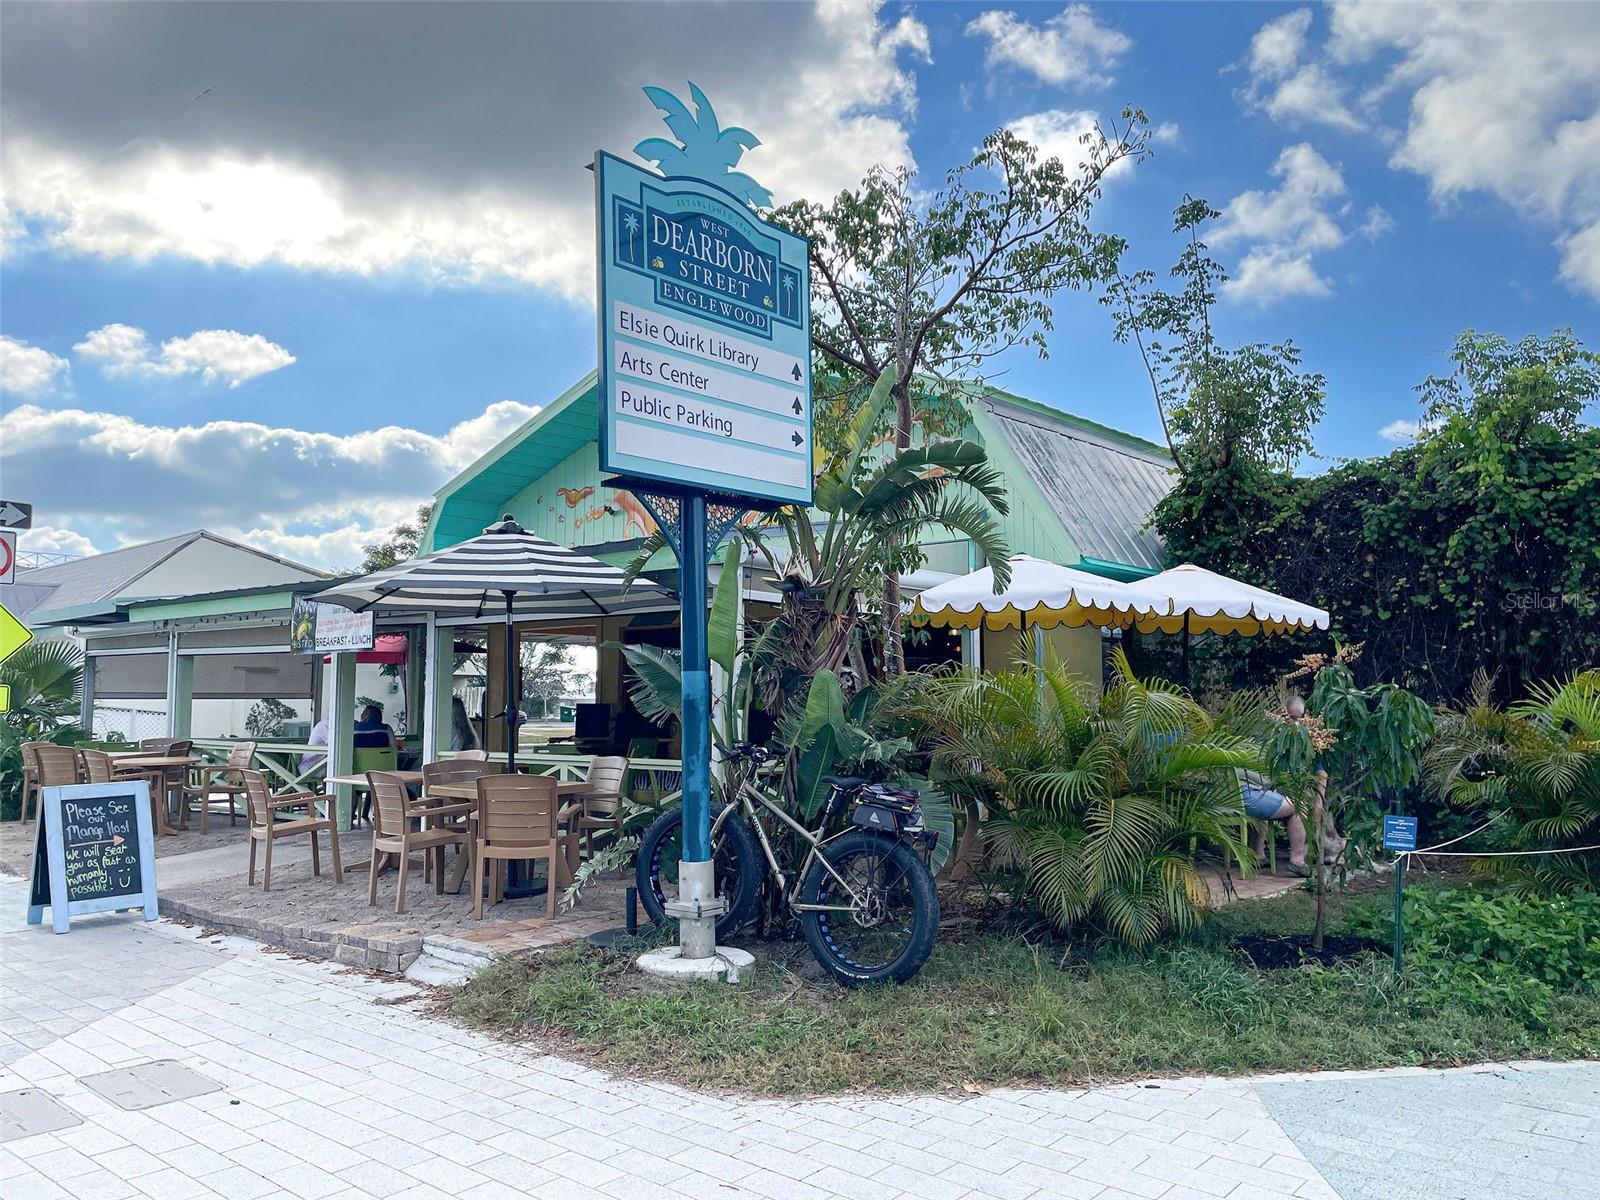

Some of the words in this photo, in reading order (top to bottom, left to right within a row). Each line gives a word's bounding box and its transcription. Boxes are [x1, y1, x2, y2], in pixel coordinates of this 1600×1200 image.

[676, 199, 733, 221] ESTABLISHED
[700, 217, 730, 238] WEST
[652, 213, 773, 286] DEARBORN
[679, 259, 750, 299] STREET
[663, 283, 766, 328] ENGLEWOOD
[619, 310, 659, 339] Elsie
[663, 325, 705, 353] Quirk
[709, 338, 759, 372] Library
[620, 351, 653, 376] Arts
[659, 362, 709, 390] Center
[621, 391, 672, 420] Public
[677, 404, 733, 438] Parking
[316, 635, 348, 647] BREAKFAST
[352, 634, 371, 645] LUNCH
[65, 803, 106, 823] Please
[108, 800, 130, 815] See
[87, 815, 106, 824] our
[65, 824, 104, 841] Mango
[65, 849, 81, 861] We
[83, 844, 100, 858] will
[65, 865, 108, 887] humanly
[66, 861, 84, 876] you
[87, 859, 98, 867] as
[102, 855, 121, 869] fast
[125, 856, 136, 864] as
